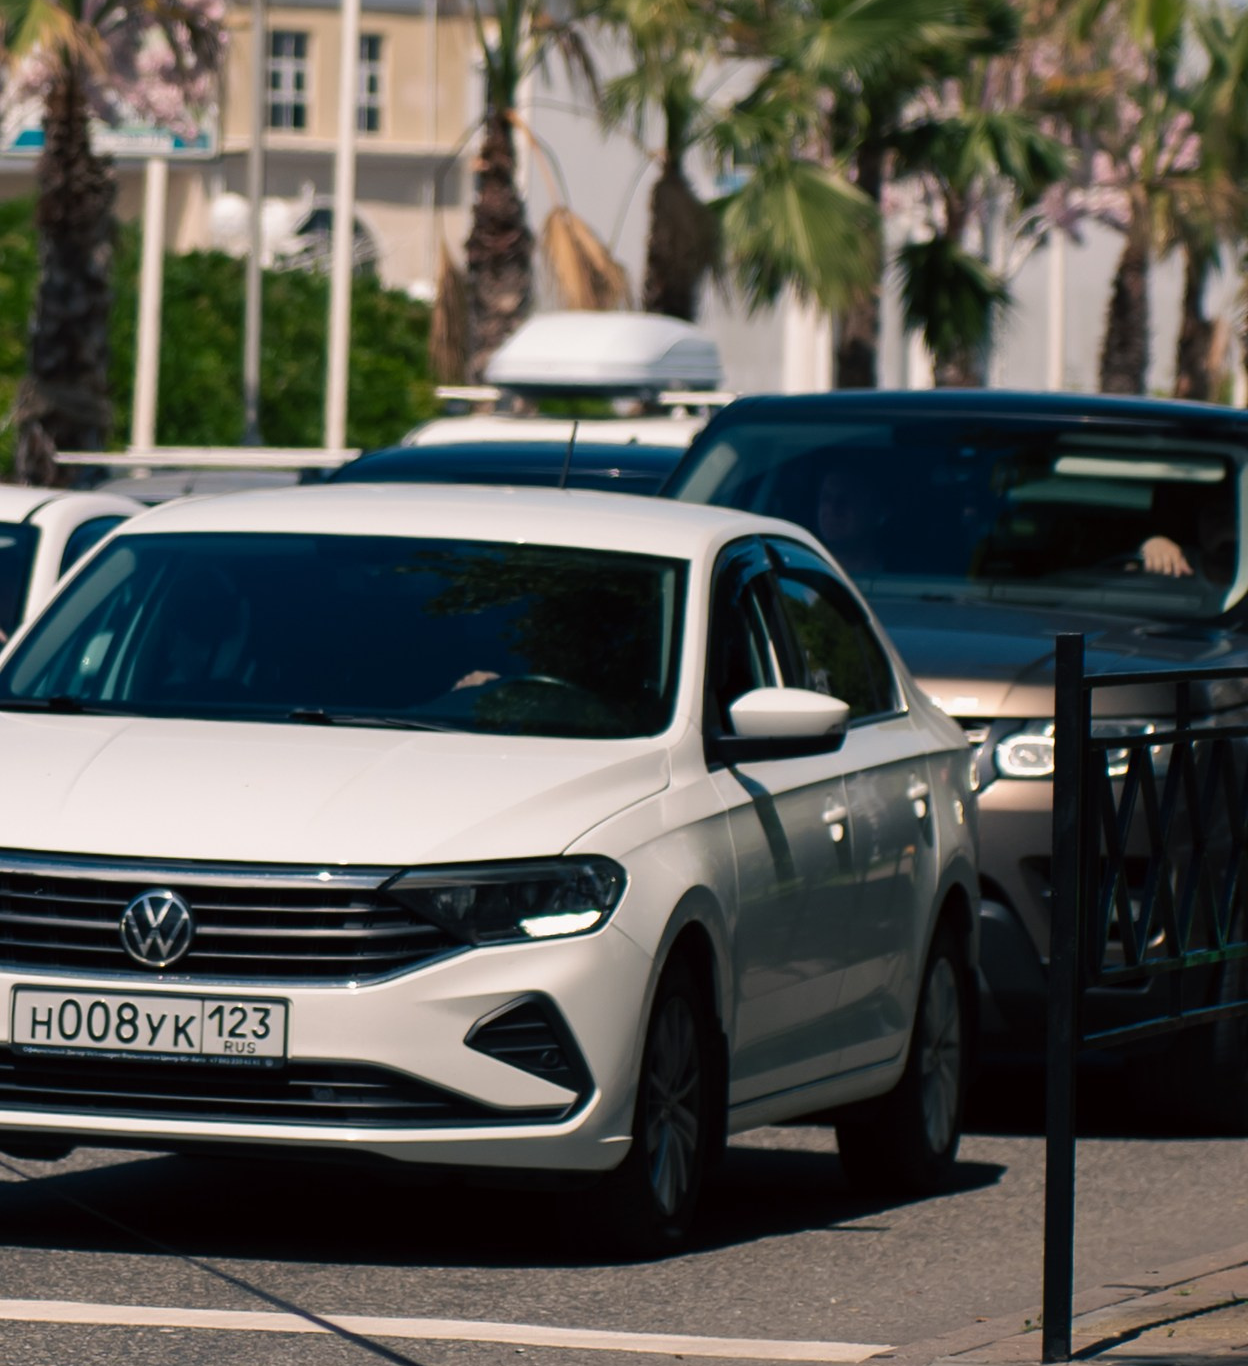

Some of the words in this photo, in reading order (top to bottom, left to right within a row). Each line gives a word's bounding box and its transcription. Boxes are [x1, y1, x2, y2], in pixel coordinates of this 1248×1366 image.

[31, 998, 197, 1048] Н008УК
[208, 1004, 272, 1039] 123
[223, 1040, 256, 1054] RUS
